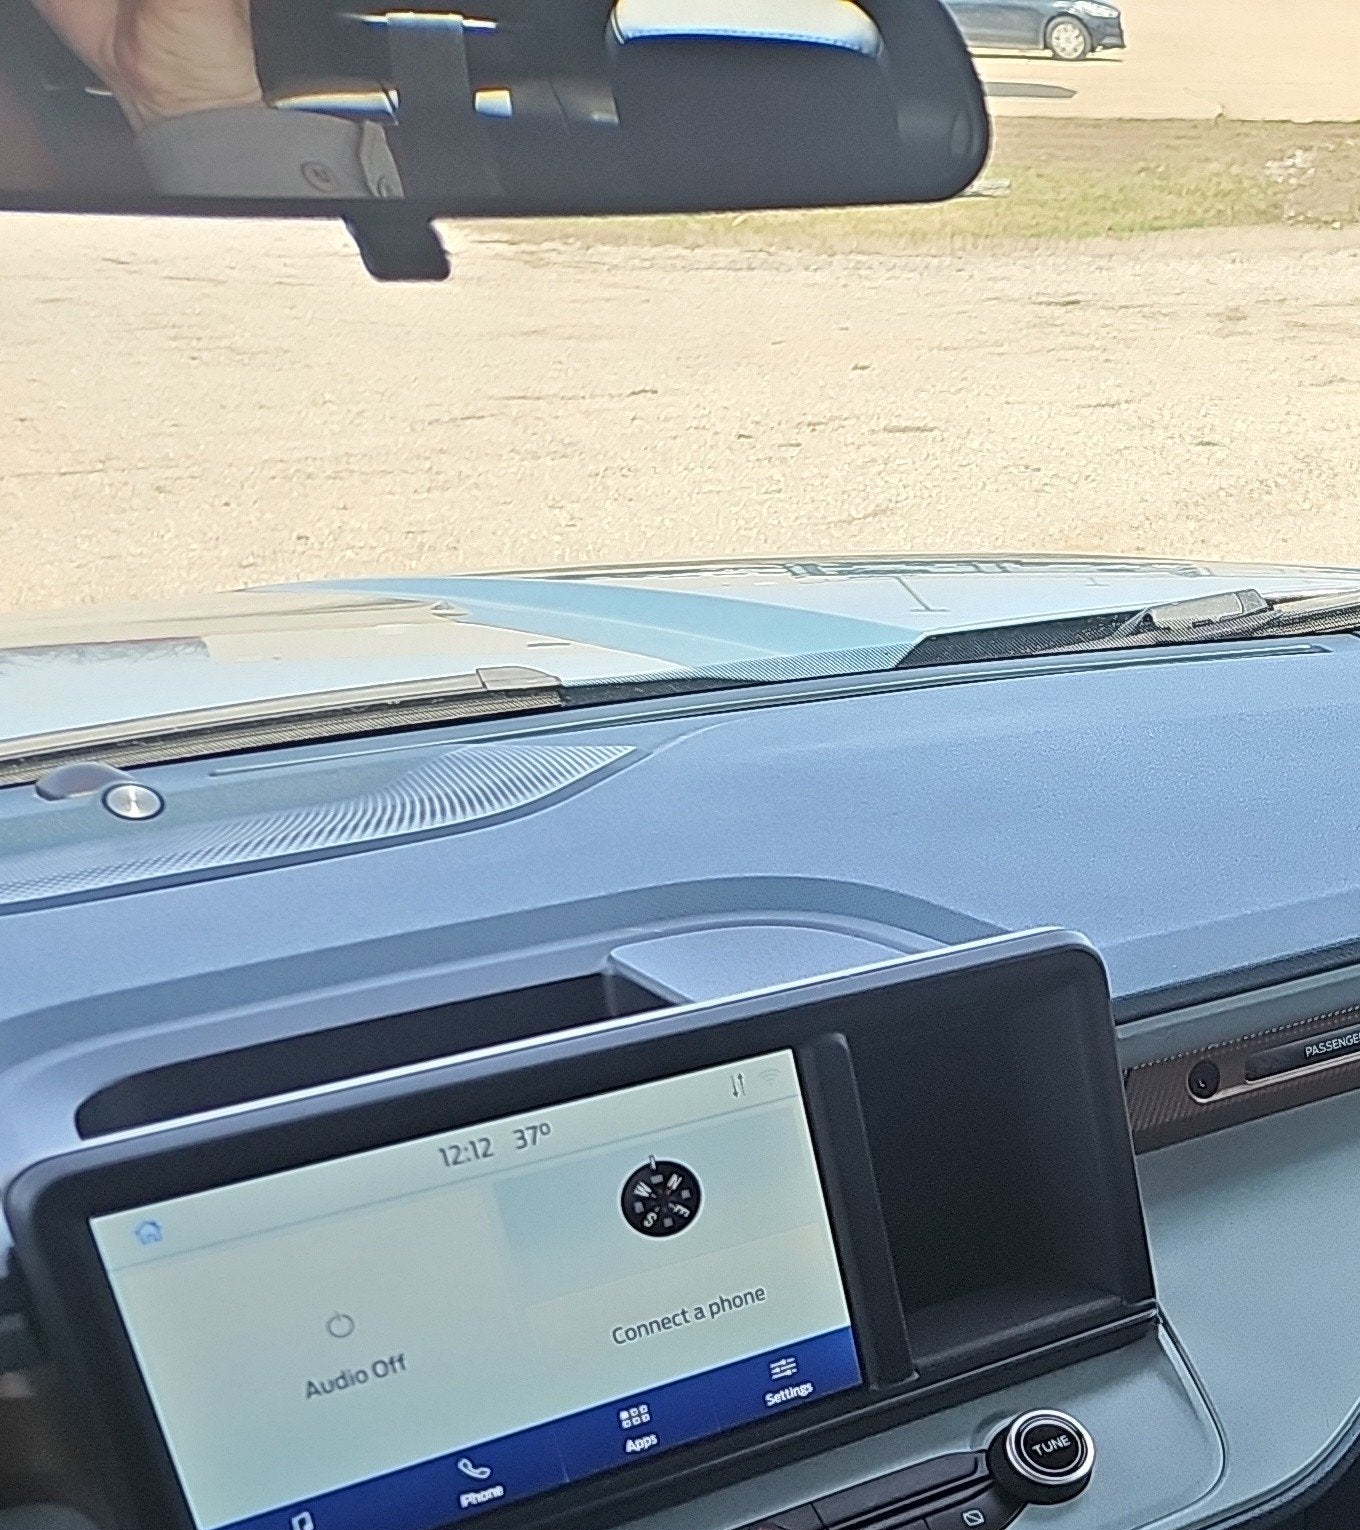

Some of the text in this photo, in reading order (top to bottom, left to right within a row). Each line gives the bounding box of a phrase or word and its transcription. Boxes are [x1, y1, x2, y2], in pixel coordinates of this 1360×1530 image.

[438, 1136, 495, 1168] 12:12
[611, 1285, 767, 1346] Connect a phone
[304, 1352, 408, 1400] Audio Off
[764, 1380, 815, 1408] Settings
[623, 1432, 659, 1454] Apps
[1031, 1433, 1072, 1459] TUNE
[459, 1484, 505, 1510] Phone
